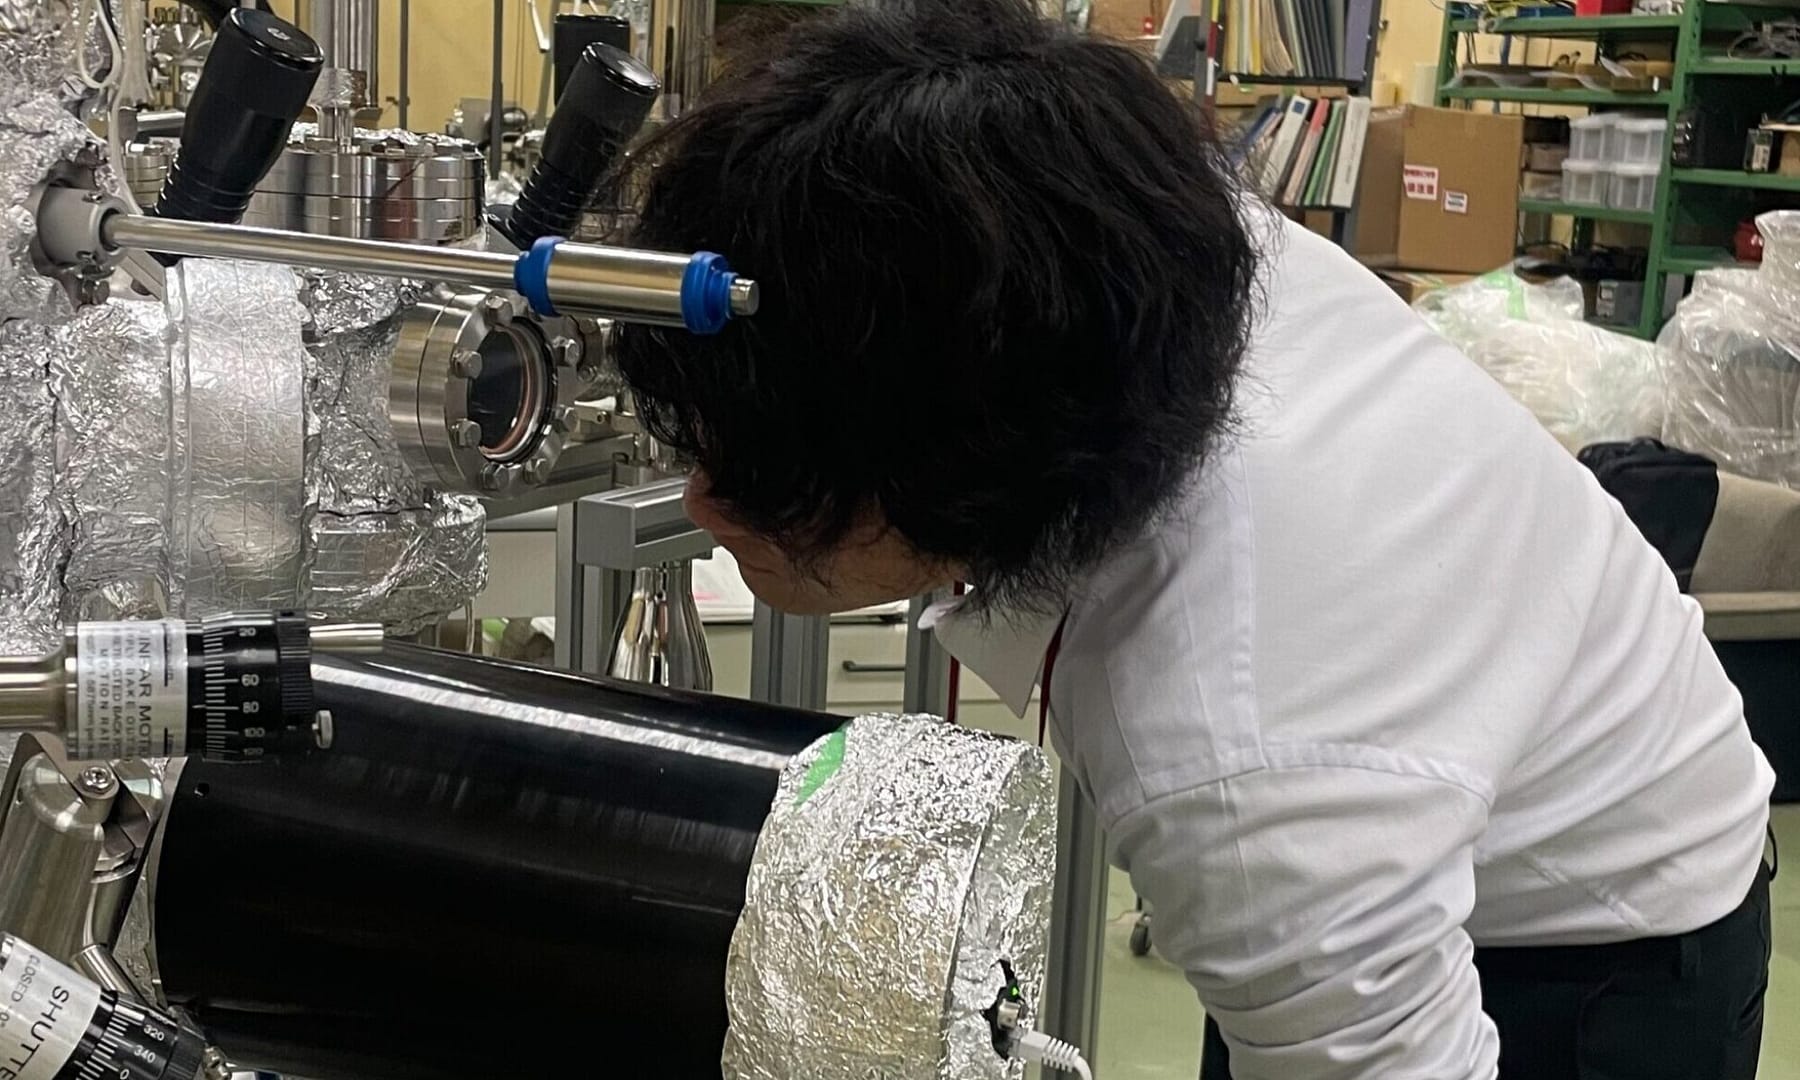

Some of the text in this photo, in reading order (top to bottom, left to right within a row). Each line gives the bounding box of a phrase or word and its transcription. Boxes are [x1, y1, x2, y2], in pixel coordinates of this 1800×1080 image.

[238, 627, 256, 637] 20
[240, 673, 260, 687] 60
[242, 701, 260, 714] 80
[243, 726, 266, 738] 100
[11, 954, 40, 1002] CLOSED
[143, 1024, 165, 1041] 320
[133, 1044, 156, 1063] 340
[119, 1068, 130, 1080] 0
